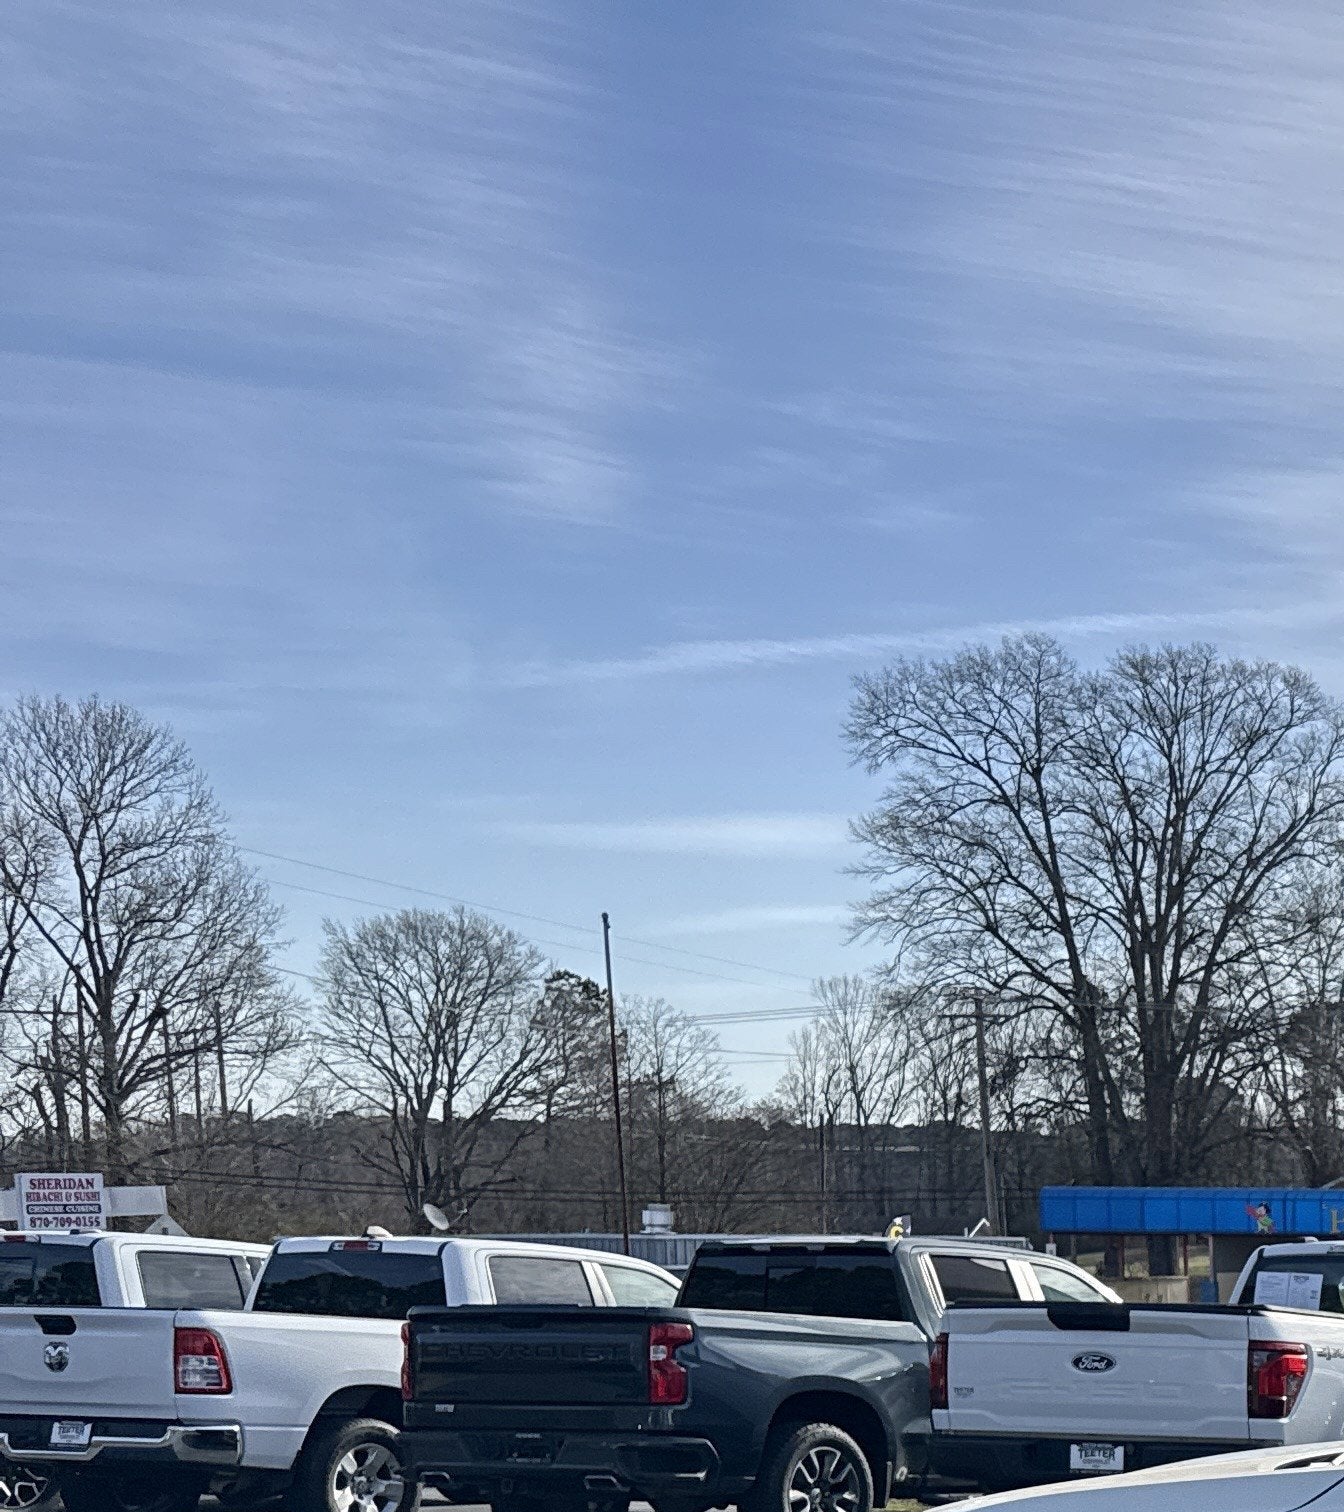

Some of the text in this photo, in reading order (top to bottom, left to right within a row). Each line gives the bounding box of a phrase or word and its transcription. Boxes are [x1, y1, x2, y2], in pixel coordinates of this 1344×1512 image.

[29, 1178, 95, 1190] SHERIDAN
[26, 1191, 63, 1202] HIBACHI
[73, 1191, 100, 1202] SUSHI
[29, 1216, 101, 1228] 870-709-0155
[1078, 1447, 1115, 1461] TEETER
